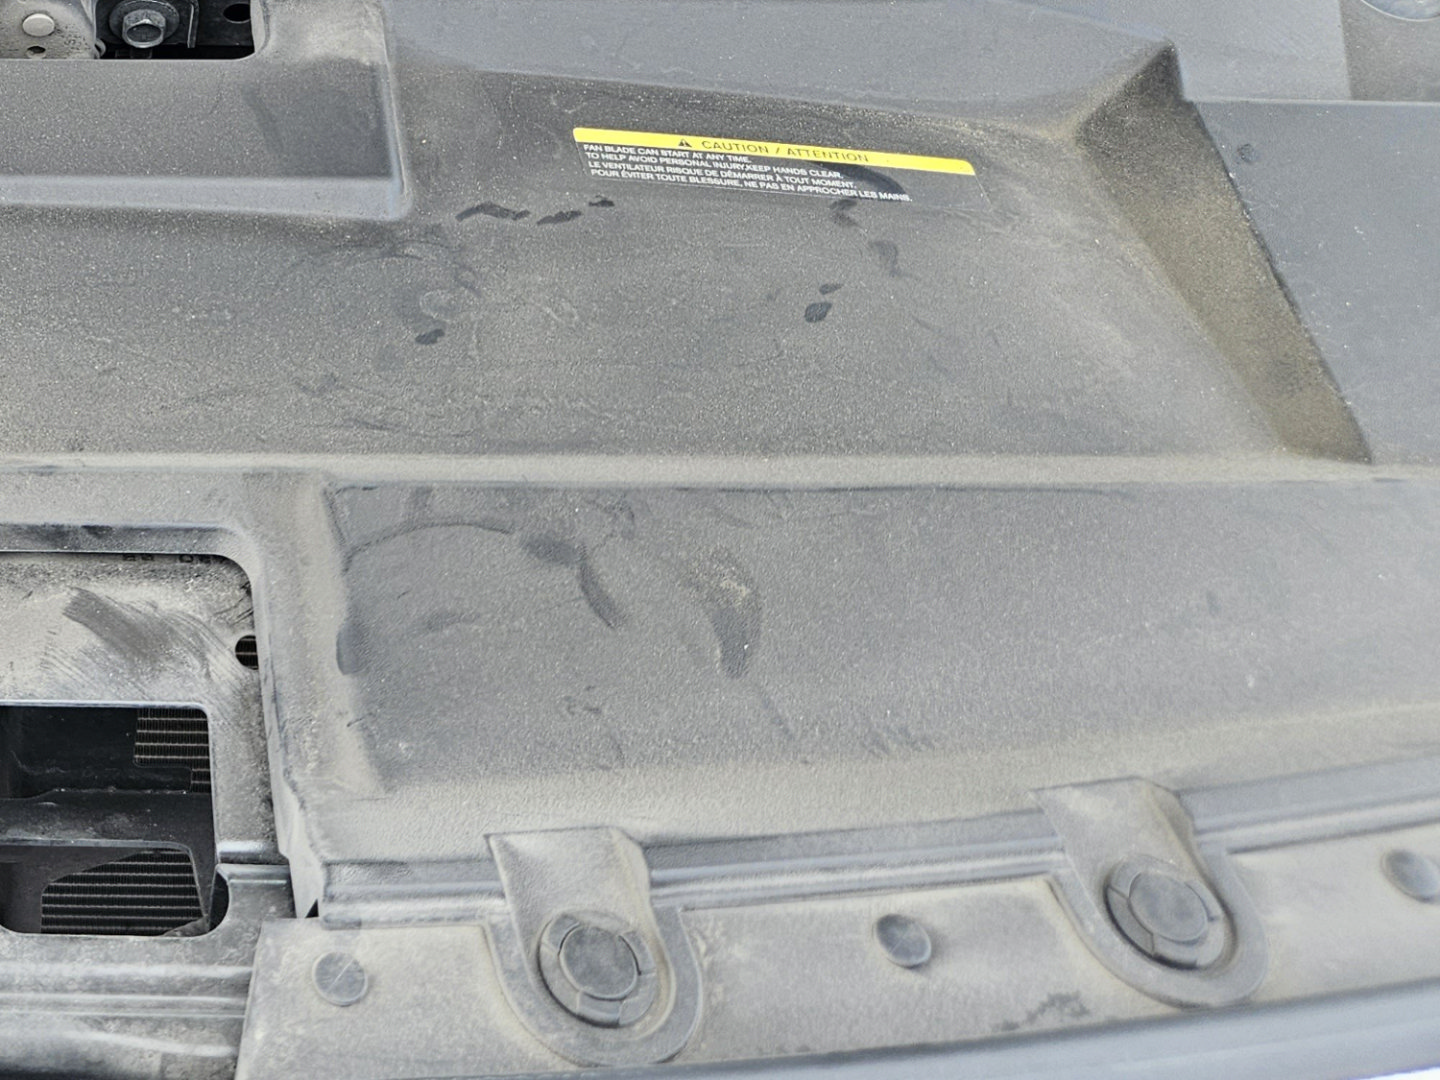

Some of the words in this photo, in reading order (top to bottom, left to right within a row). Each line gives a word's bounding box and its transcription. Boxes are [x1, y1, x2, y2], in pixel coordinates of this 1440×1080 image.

[583, 144, 603, 152] FAN
[604, 145, 636, 155] BLADE
[637, 148, 659, 156] CAN
[660, 149, 690, 158] START
[692, 151, 703, 159] AT
[706, 152, 725, 161] ANY
[726, 154, 752, 163] TIME.
[701, 140, 769, 154] CAUTION
[787, 148, 869, 162] ATTENTION
[585, 151, 599, 160] TO
[601, 153, 627, 161] HELP
[628, 155, 658, 163] AVOID
[659, 157, 712, 168] PERSONAL
[772, 166, 808, 176] HANDS
[809, 169, 844, 179] CLEAR.
[602, 162, 665, 173] VENTILATEUR
[666, 166, 703, 176] RISQUE
[704, 169, 719, 177] DE
[720, 169, 774, 181] DÉMARRER
[783, 175, 810, 185] TOUT
[811, 178, 857, 189] MOMENT.
[590, 169, 620, 178] POUR
[621, 169, 654, 180] ÉVITER
[654, 174, 688, 182] TOUTE
[743, 180, 758, 188] NE
[758, 182, 779, 190] PAS
[780, 184, 795, 192] EN
[797, 185, 858, 197] APPROCHER
[858, 190, 878, 199] LES
[878, 191, 913, 202] MAINS.
